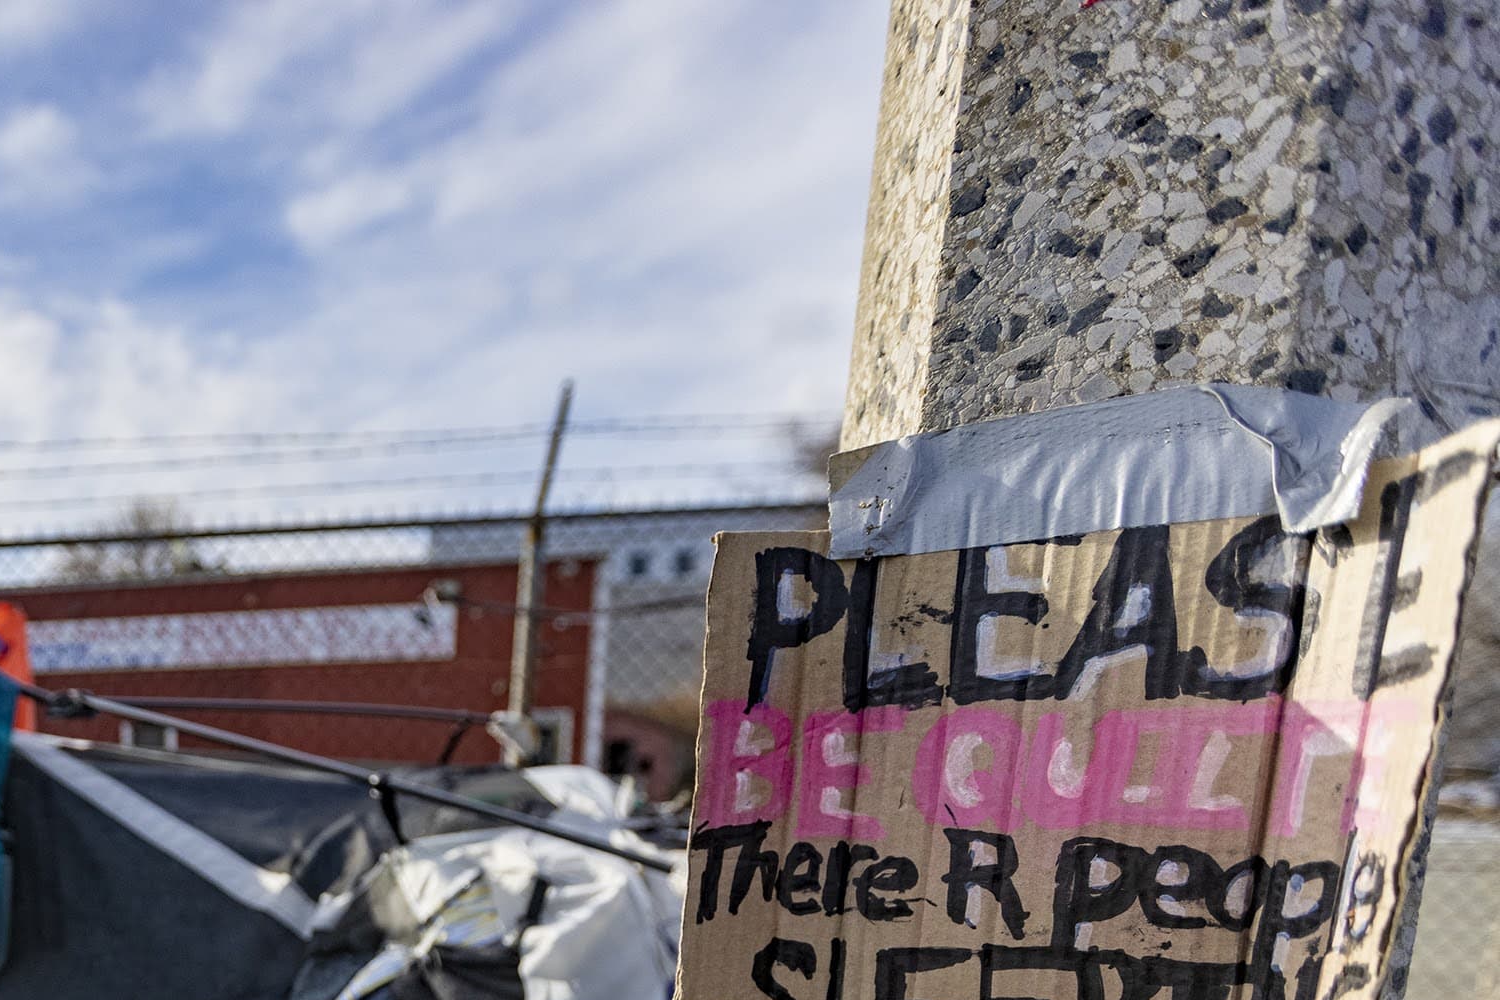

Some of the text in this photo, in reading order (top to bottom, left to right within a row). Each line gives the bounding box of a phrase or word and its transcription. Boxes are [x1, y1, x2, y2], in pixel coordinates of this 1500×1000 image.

[747, 451, 1480, 712] PLEASE
[698, 699, 913, 841] BE
[691, 820, 930, 923] There
[942, 826, 1030, 939] R
